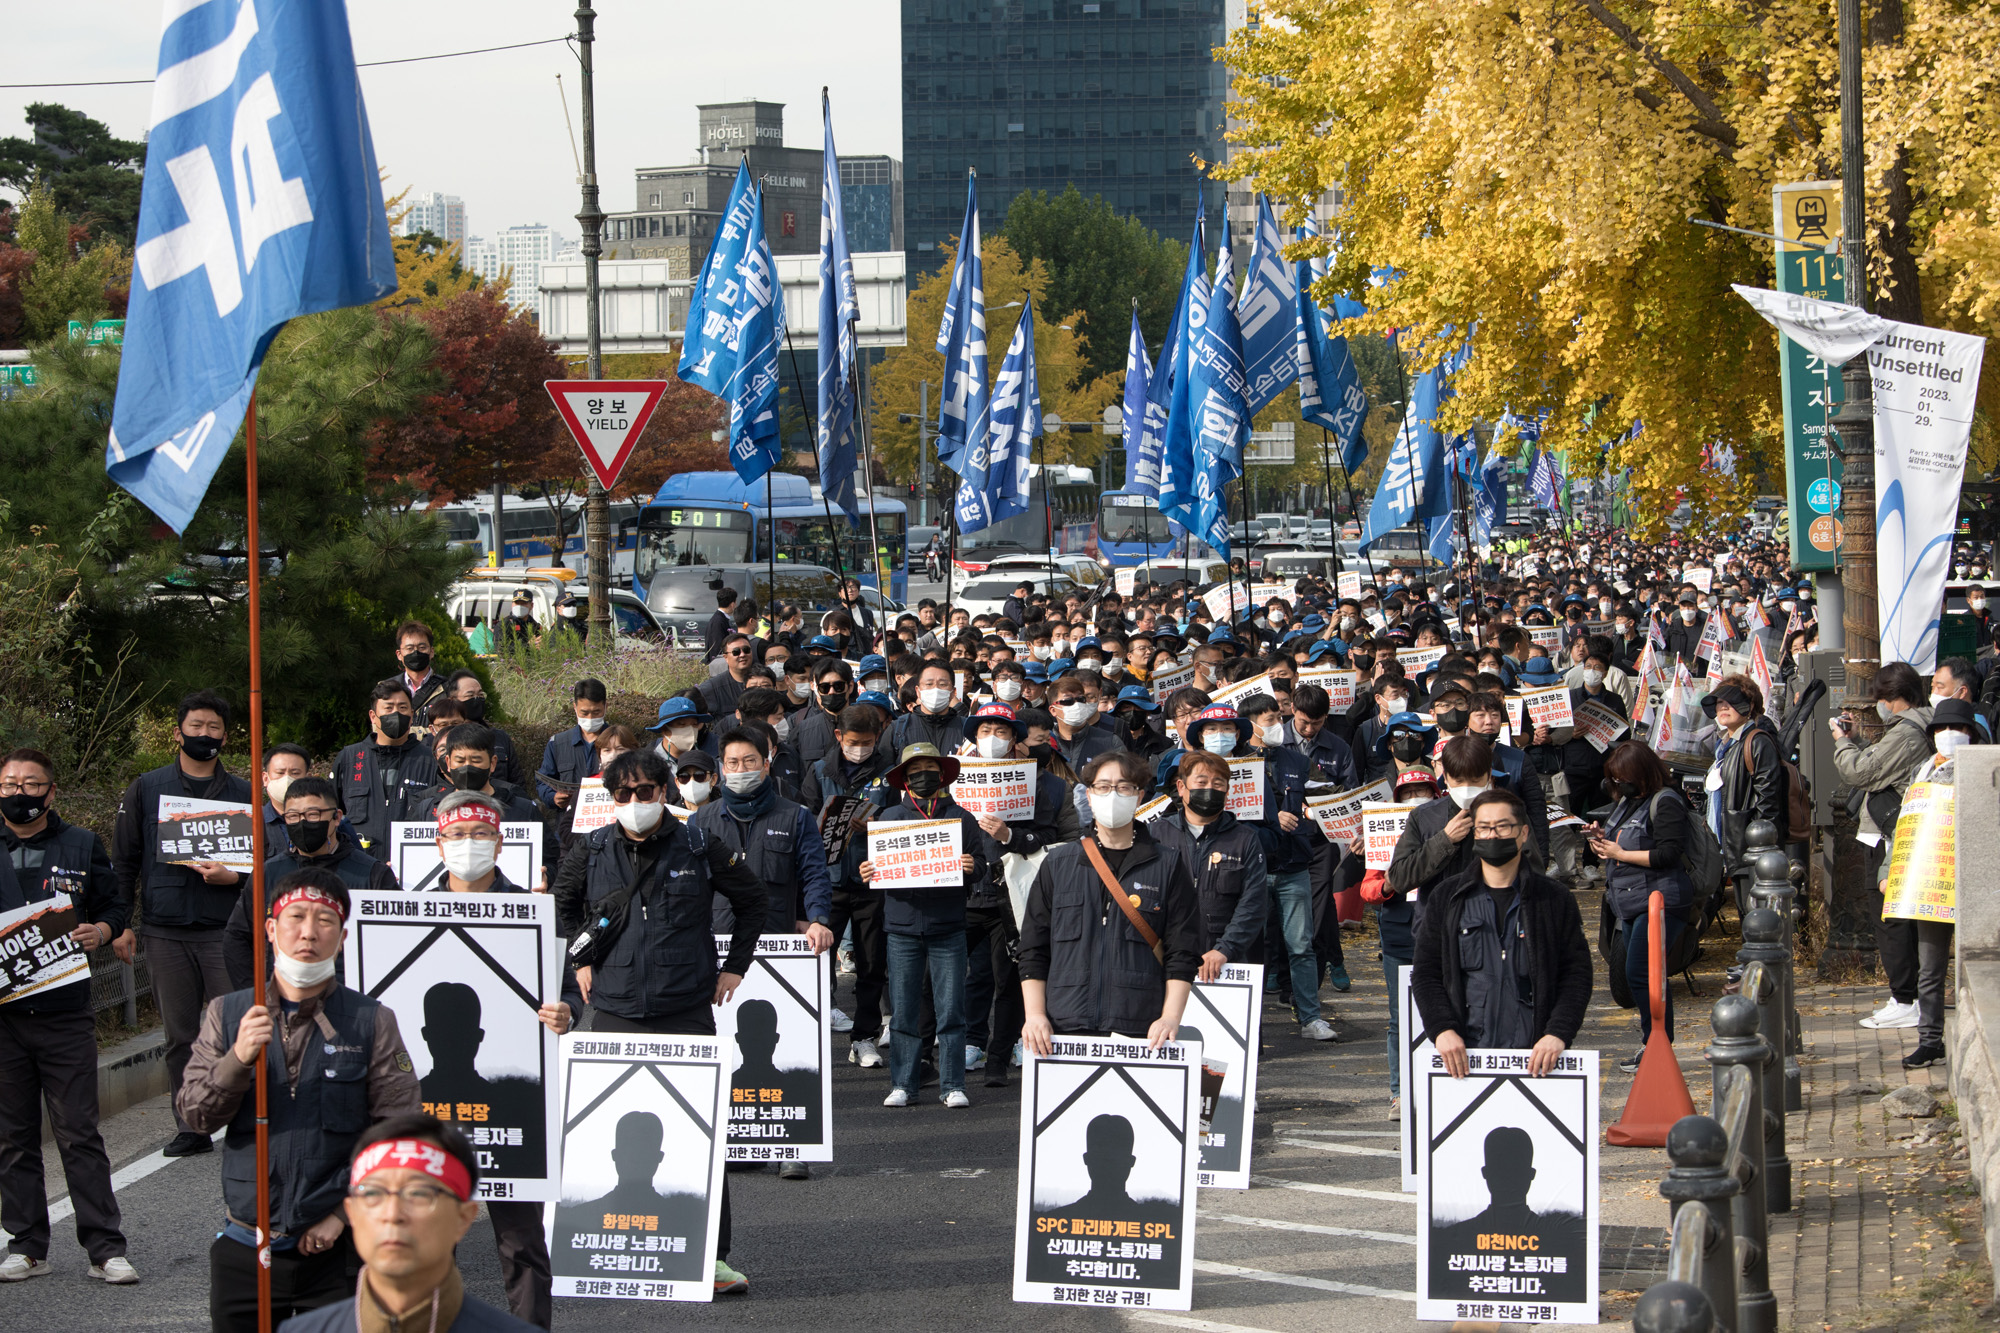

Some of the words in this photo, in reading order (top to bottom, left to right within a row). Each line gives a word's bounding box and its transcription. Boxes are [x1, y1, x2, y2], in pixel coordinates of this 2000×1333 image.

[708, 128, 746, 140] HOTEL
[756, 127, 783, 139] HOTEL
[1796, 255, 1826, 288] 11
[1870, 350, 1964, 384] Unsettled
[1920, 387, 1952, 402] 2023.
[1917, 401, 1935, 413] 01.
[586, 418, 629, 430] YIELD
[1915, 414, 1933, 427] 29.
[1113, 497, 1129, 506] 152
[670, 510, 722, 528] 501
[1420, 652, 1441, 663] 정부는
[1158, 676, 1182, 690] 윤석열
[1323, 677, 1349, 687] 정부는
[1333, 687, 1350, 696] 처벌
[1540, 693, 1564, 703] 정부는
[1551, 701, 1567, 711] 처벌
[1540, 709, 1572, 722] 중단하라!
[956, 772, 987, 784] 윤석열
[990, 770, 1026, 784] 정부는
[955, 786, 1002, 799] 중대재해
[1004, 783, 1028, 797] 처벌
[1232, 781, 1256, 795] 처벌
[985, 796, 1035, 813] 중단하라!
[474, 807, 497, 824] 투쟁
[1318, 806, 1350, 820] 윤석열
[181, 819, 231, 837] 더이상
[574, 817, 606, 828] 무력화
[1368, 819, 1395, 832] 윤석열
[504, 828, 530, 839] 처벌!
[875, 836, 911, 852] 윤석열
[914, 831, 950, 846] 정부는
[1325, 830, 1355, 840] 무력화
[161, 839, 194, 854] 죽을
[198, 838, 214, 853] 수
[875, 849, 927, 868] 중대재해
[929, 845, 954, 859] 처벌
[1366, 851, 1391, 863] 무력화
[871, 867, 906, 883] 무력화
[910, 859, 962, 877] 중단하라!
[361, 900, 419, 917] 중대재해
[424, 902, 497, 919] 최고책임자
[502, 903, 537, 920] 처벌!
[1919, 904, 1934, 916] 즉각
[13, 958, 34, 977] 수
[1225, 968, 1251, 982] 처벌!
[572, 1041, 621, 1056] 중대재해
[624, 1042, 686, 1058] 최고책임자
[688, 1044, 718, 1059] 처벌!
[1091, 1043, 1153, 1060] 최고책임자
[1156, 1047, 1186, 1062] 처벌!
[732, 1088, 757, 1103] 철도
[758, 1088, 783, 1103] 현장
[456, 1102, 490, 1122] 현장
[758, 1106, 807, 1121] 노동자를
[726, 1124, 790, 1138] 추모합니다.
[750, 1147, 772, 1159] 진상
[774, 1147, 799, 1160] 규명!
[478, 1182, 514, 1198] 규명!
[602, 1213, 659, 1232] 화일약품
[1036, 1217, 1068, 1233] SPC
[1071, 1218, 1141, 1238] 파리바게트
[1144, 1222, 1176, 1239] SPL
[571, 1233, 628, 1250] 산재사망
[630, 1236, 687, 1253] 노동자를
[1047, 1238, 1103, 1256] 산재사망
[1106, 1241, 1163, 1260] 노동자를
[1476, 1233, 1540, 1251] 여천NCC
[589, 1254, 664, 1273] 추모합니다.
[1066, 1260, 1141, 1280] 추모합니다.
[1447, 1254, 1506, 1272] 산재사망
[1509, 1256, 1568, 1274] 노동자를
[575, 1280, 613, 1295] 철저한
[615, 1281, 641, 1296] 진상
[643, 1283, 674, 1298] 규명!
[1468, 1275, 1546, 1294] 추모합니다.
[1053, 1287, 1090, 1303] 철저한
[1093, 1288, 1118, 1304] 진상
[1121, 1290, 1151, 1306] 규명!
[1456, 1303, 1494, 1318] 철저한
[1497, 1304, 1523, 1319] 진상
[1527, 1305, 1558, 1320] 규명!
